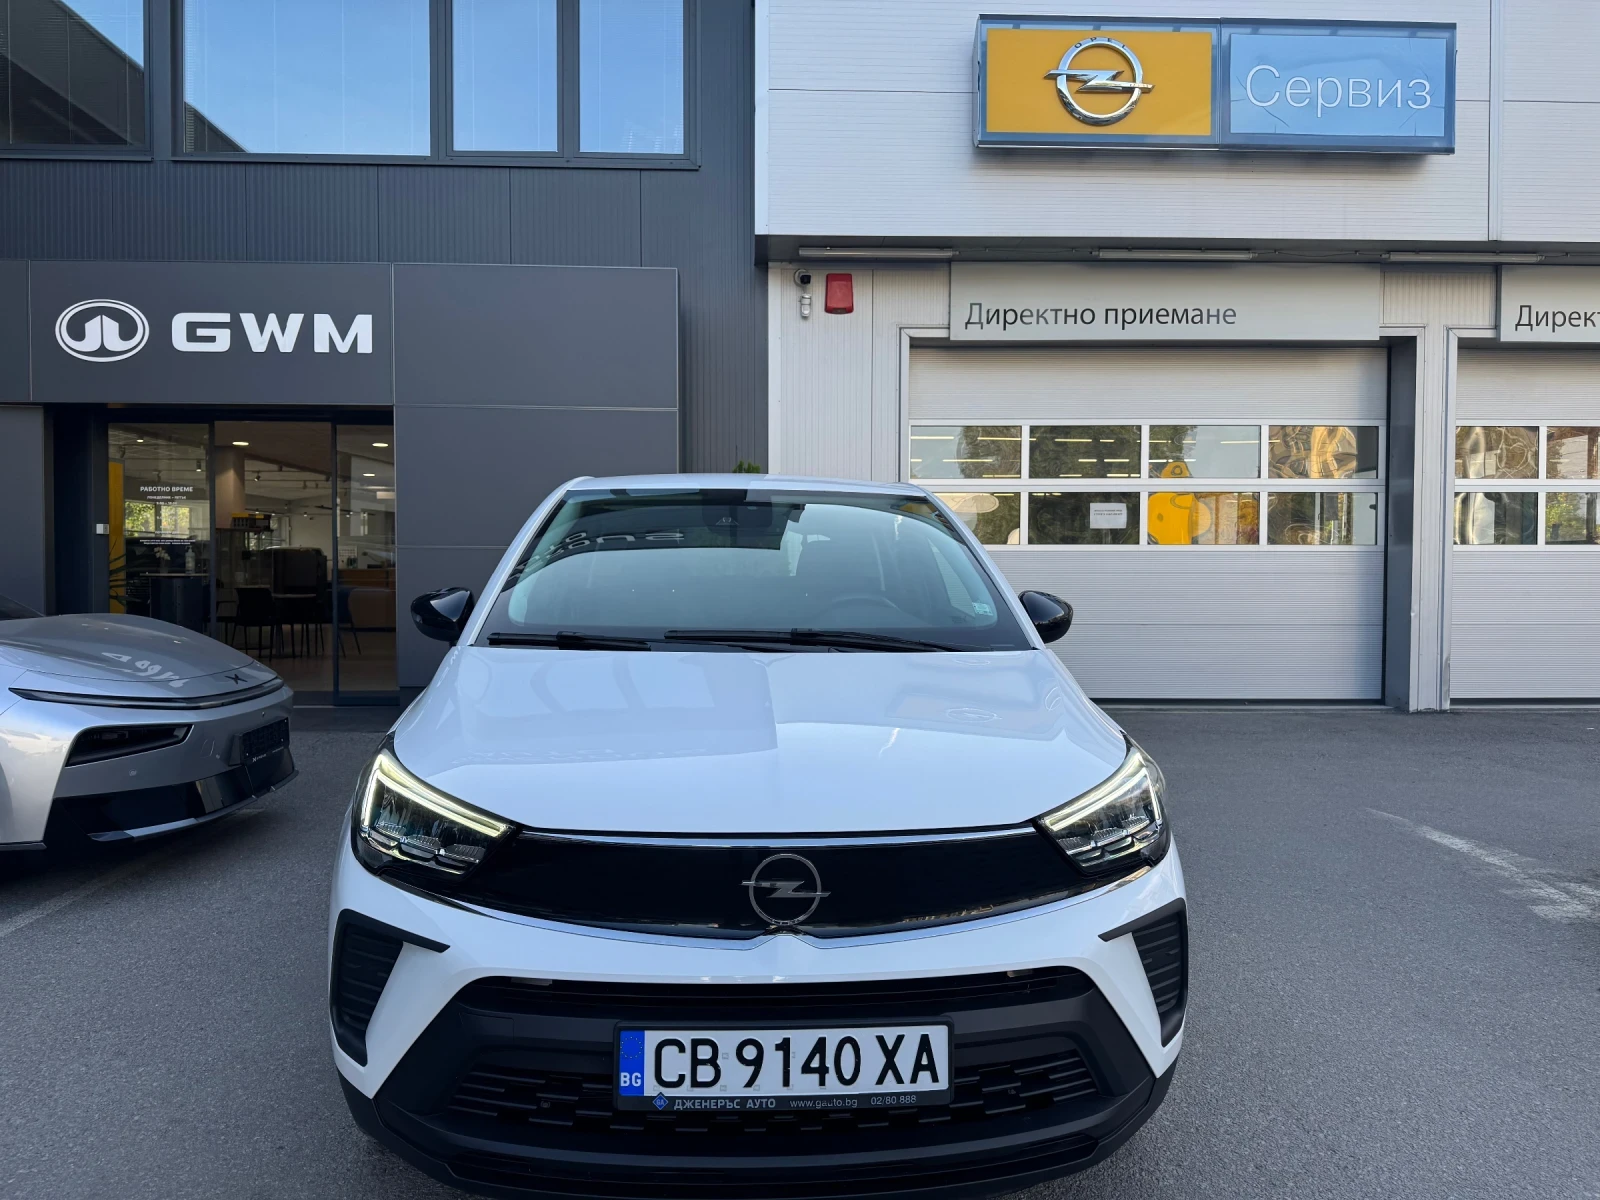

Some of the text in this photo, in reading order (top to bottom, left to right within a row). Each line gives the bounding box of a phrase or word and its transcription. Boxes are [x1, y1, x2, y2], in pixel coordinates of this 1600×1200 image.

[1074, 36, 1127, 50] OPEL
[1246, 64, 1431, 118] Сервиз
[965, 302, 1237, 331] Директно приемане
[171, 312, 373, 354] GWM
[735, 1036, 862, 1088] 9140
[620, 1072, 642, 1087] BG
[673, 1098, 741, 1111] ДЖЕНЕРЪС
[746, 1098, 776, 1109] АУТО
[789, 1098, 858, 1109] www.gauto.bg
